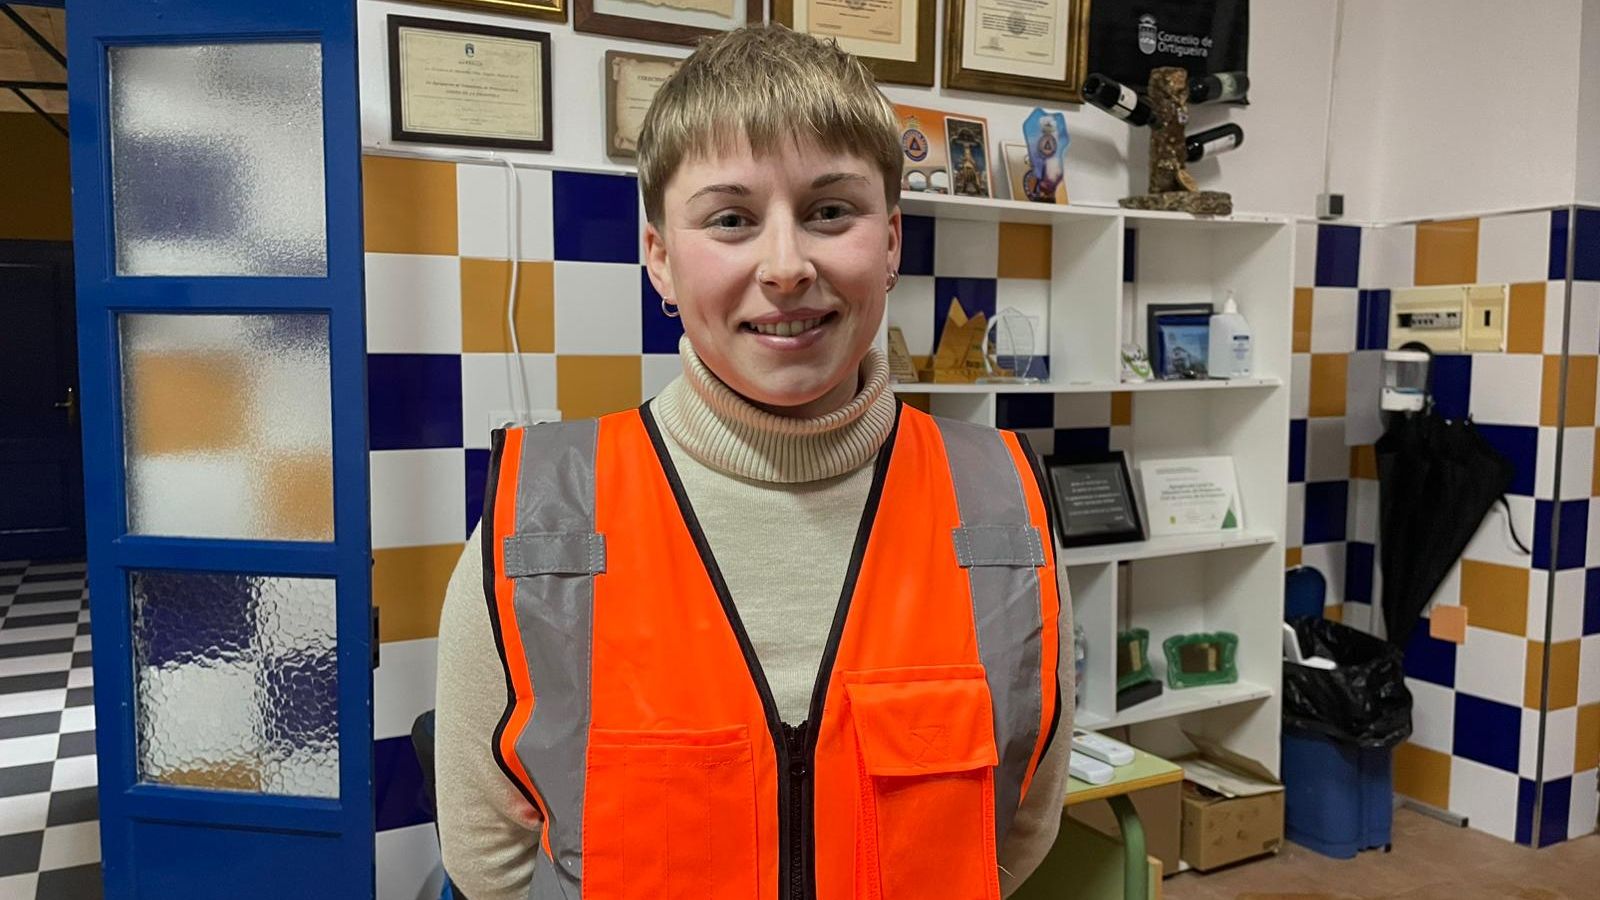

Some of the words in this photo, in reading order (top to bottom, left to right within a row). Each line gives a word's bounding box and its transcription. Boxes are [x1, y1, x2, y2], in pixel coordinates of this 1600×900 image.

[1158, 31, 1200, 45] Concello
[1201, 36, 1213, 48] de
[1158, 42, 1208, 57] Ortigueira
